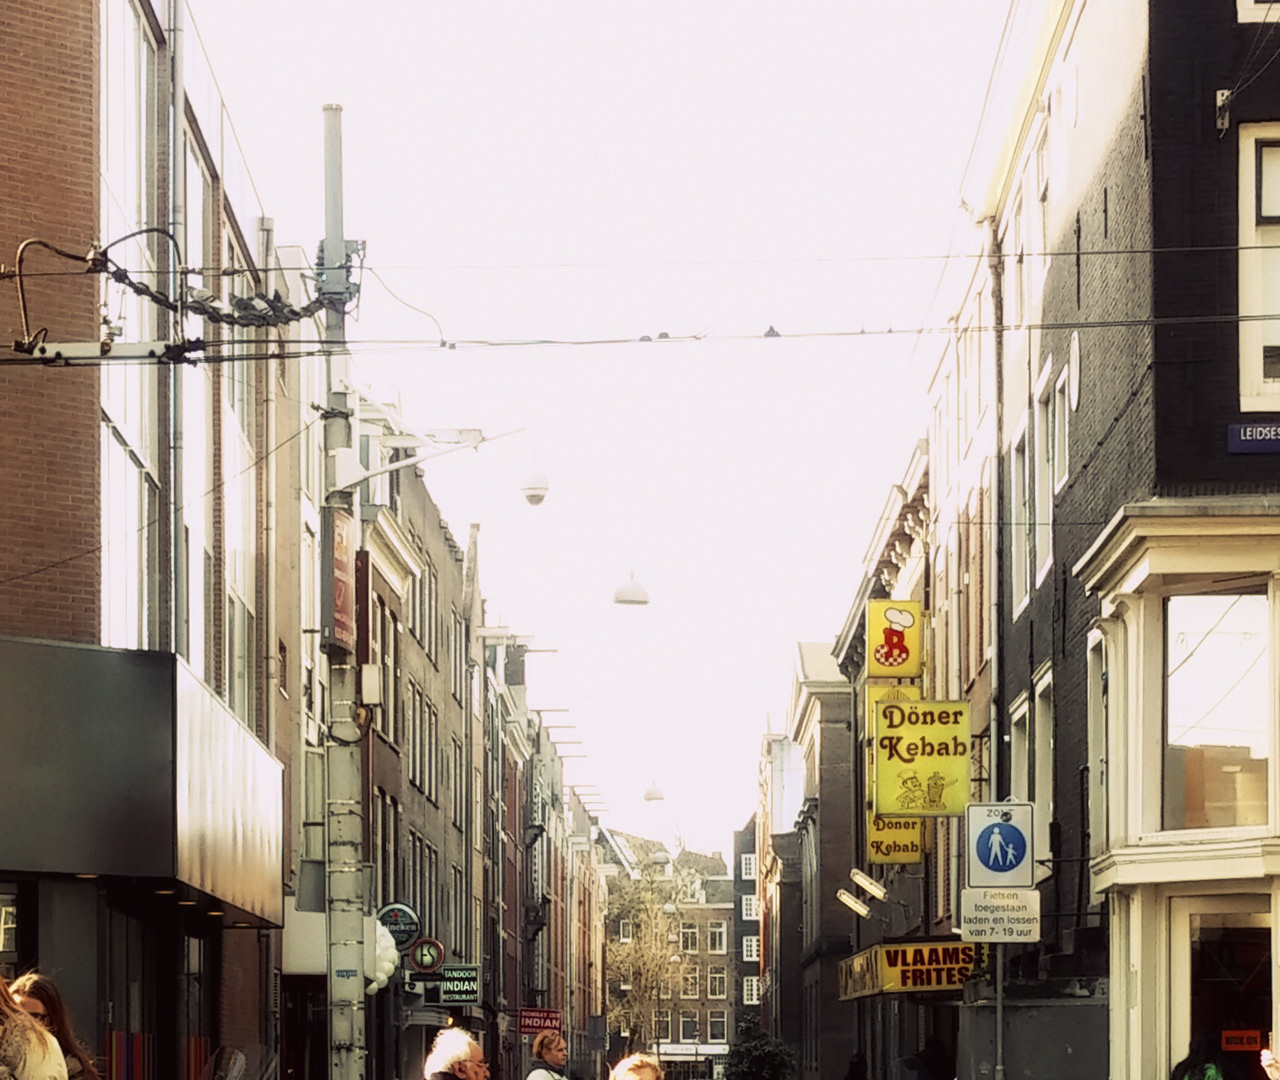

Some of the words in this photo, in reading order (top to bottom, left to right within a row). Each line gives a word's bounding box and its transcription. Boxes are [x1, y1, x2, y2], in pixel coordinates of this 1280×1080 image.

[882, 704, 964, 729] Döner
[879, 736, 967, 763] Kebab
[987, 809, 1014, 818] ZO
[871, 840, 919, 856] Kebab
[983, 891, 1019, 900] Fietsen
[974, 903, 1027, 914] toegestaan
[963, 915, 990, 924] laden
[993, 917, 1005, 925] en
[1006, 915, 1039, 925] lossen
[968, 928, 987, 936] van
[1002, 927, 1014, 936] 19
[1016, 928, 1032, 936] uur
[885, 946, 974, 967] VLAAMS
[444, 970, 476, 978] TANDOOR
[901, 966, 970, 987] FRITES
[443, 981, 477, 991] INDIAN
[521, 1017, 560, 1028] INDIAN
